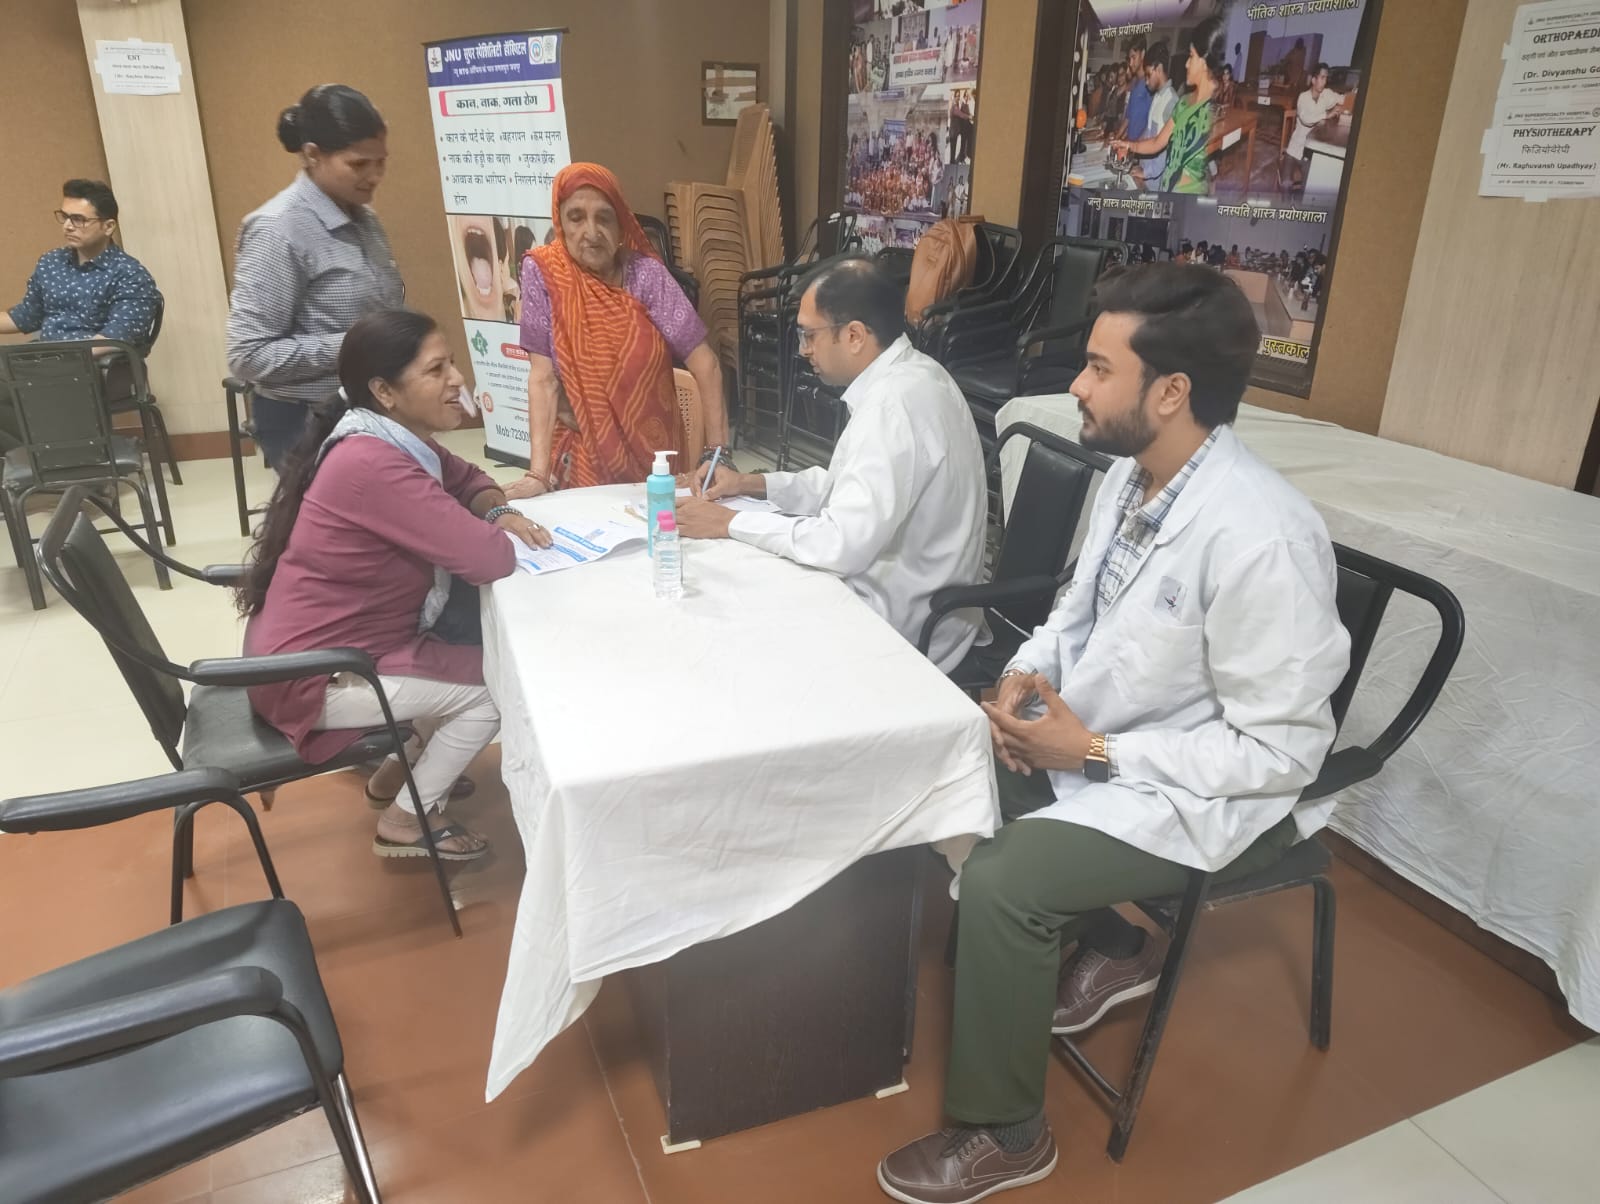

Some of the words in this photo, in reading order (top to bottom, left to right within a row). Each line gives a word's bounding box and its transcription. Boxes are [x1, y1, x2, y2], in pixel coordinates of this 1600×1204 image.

[1279, 2, 1305, 16] शास्त्र
[1100, 24, 1117, 42] भूगोल
[1118, 22, 1153, 36] प्रयोगशाला
[444, 48, 462, 62] JNU
[1542, 66, 1587, 78] Divyanshu
[445, 133, 458, 143] कान
[1513, 126, 1596, 138] PHYSIOTHERAPY
[1512, 162, 1555, 171] Raghuvansh
[1557, 162, 1597, 171] Upadhyay)
[454, 192, 468, 206] होना
[1102, 198, 1120, 208] शास्त्र
[1121, 196, 1154, 210] प्रयोगशाला
[1217, 202, 1250, 217] वनस्पति
[1252, 206, 1277, 220] शास्त्र
[1278, 206, 1328, 224] प्रयोगशाला
